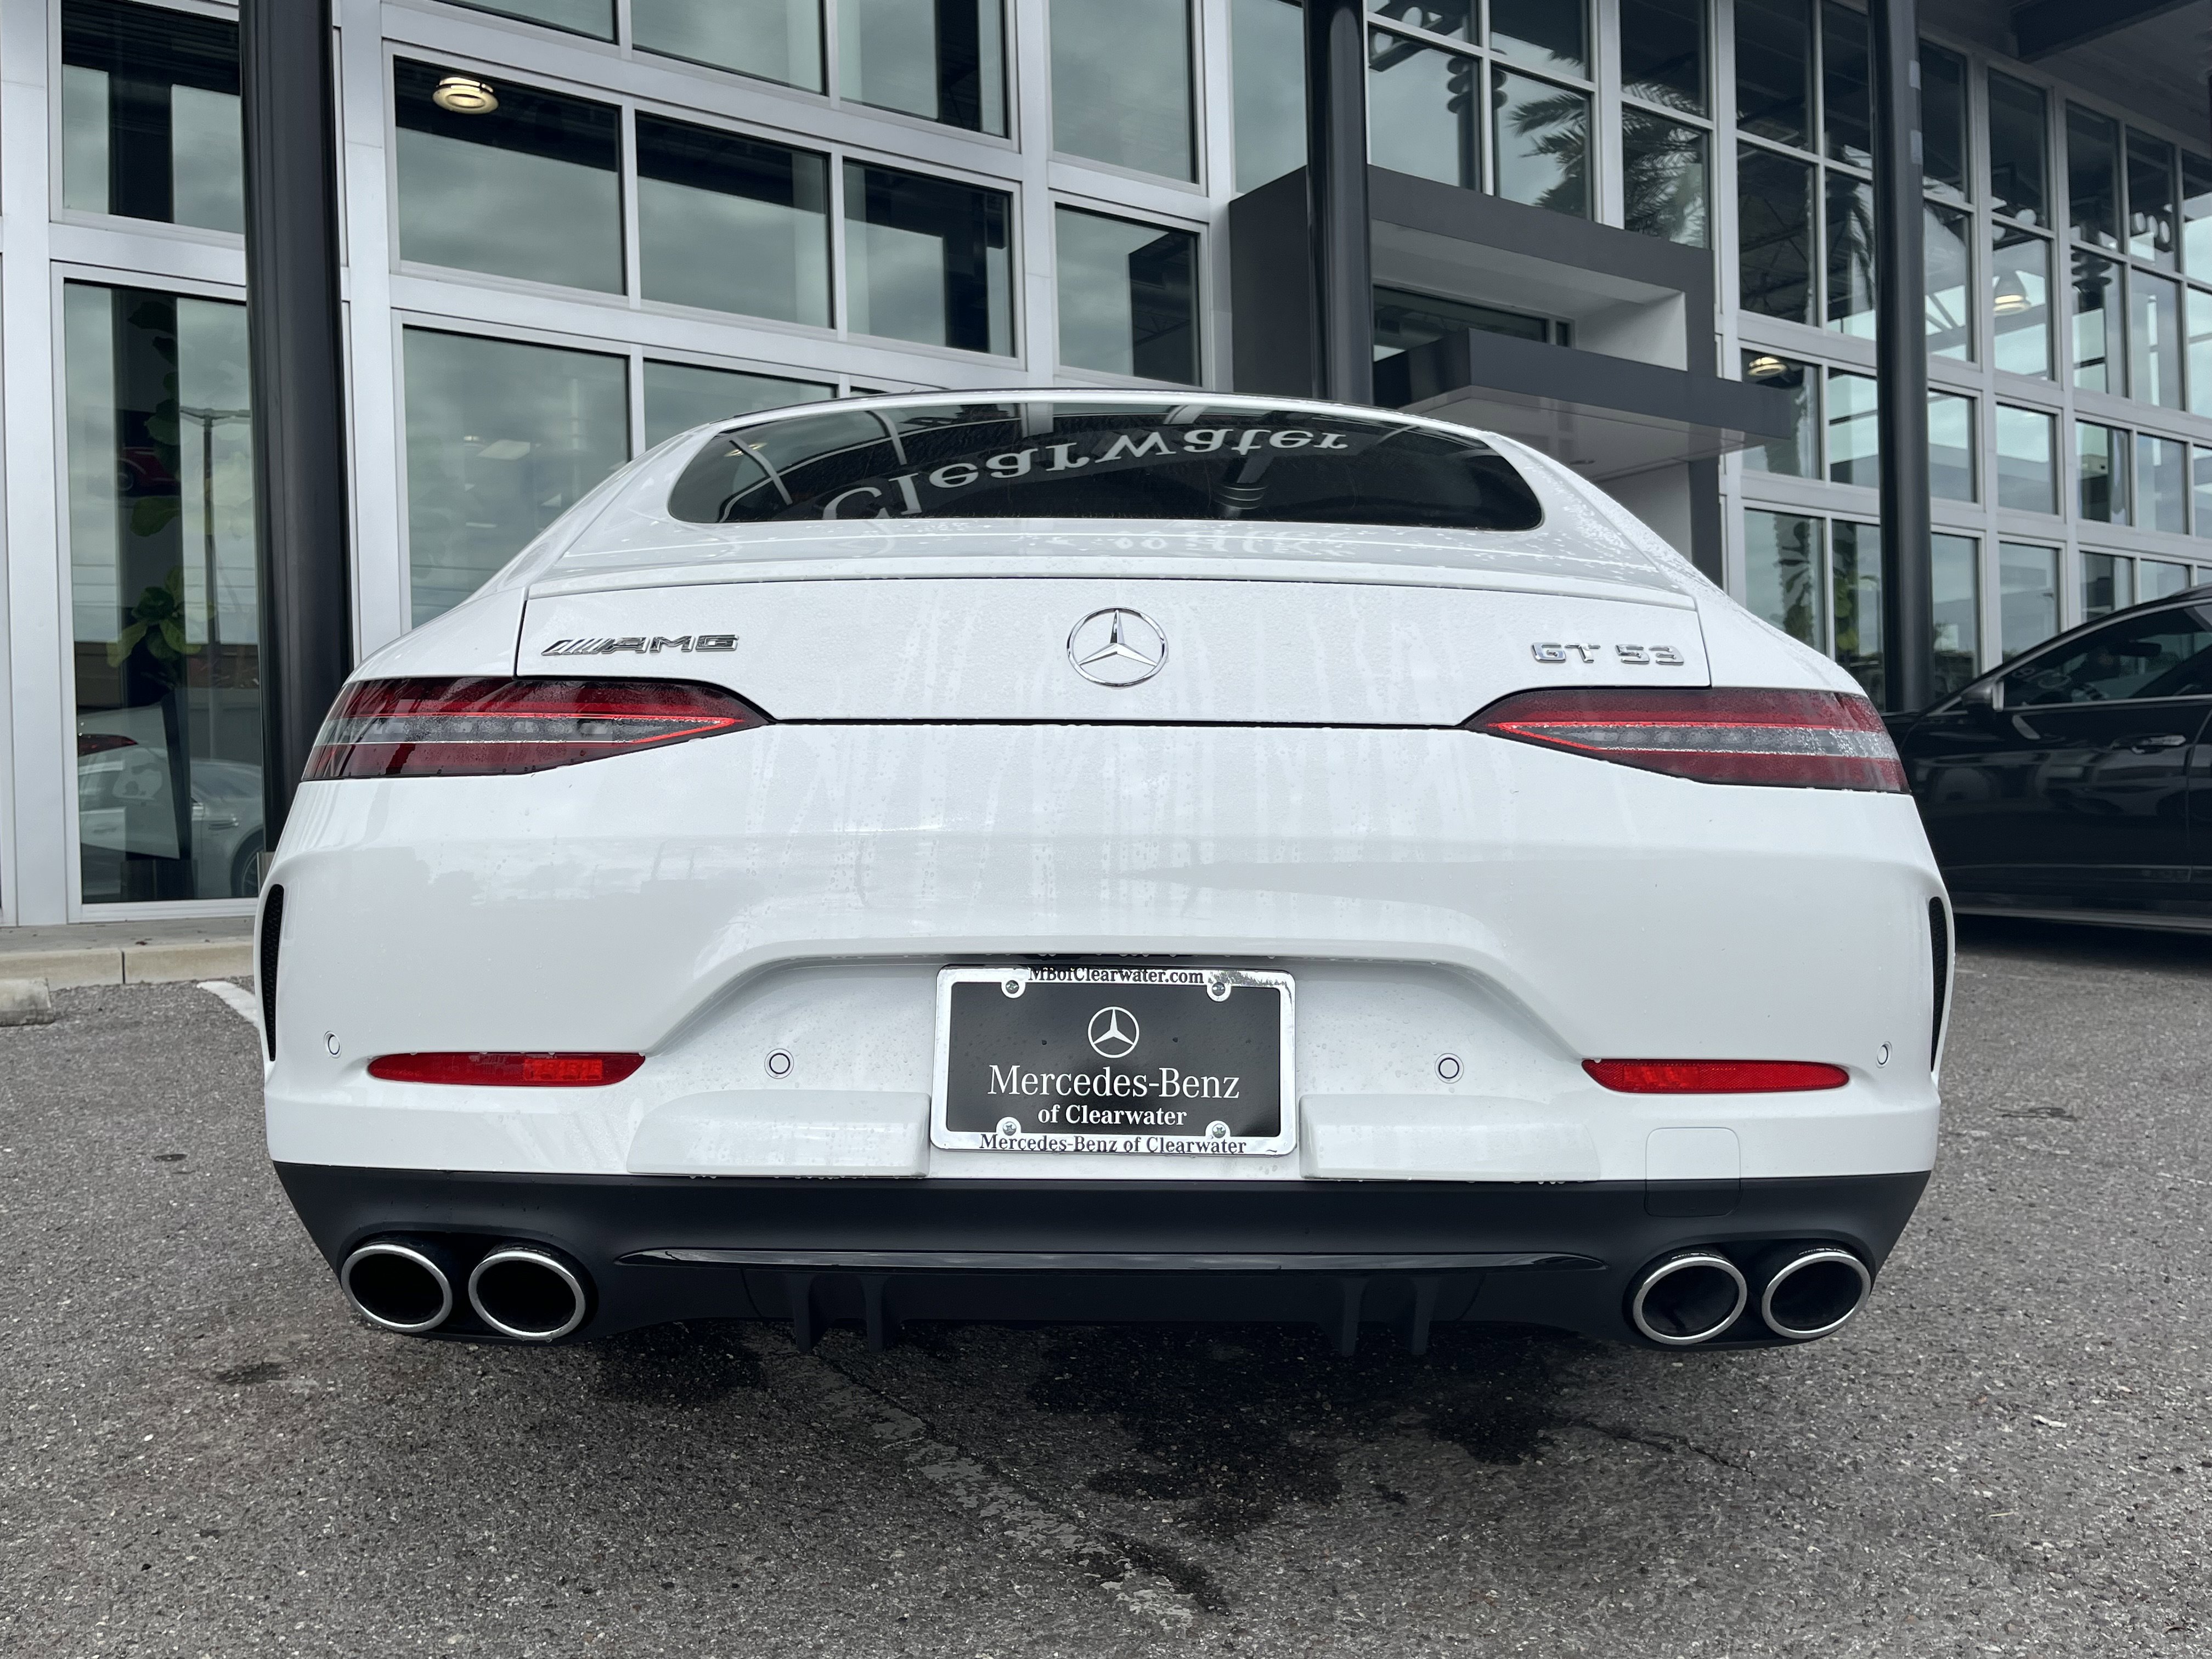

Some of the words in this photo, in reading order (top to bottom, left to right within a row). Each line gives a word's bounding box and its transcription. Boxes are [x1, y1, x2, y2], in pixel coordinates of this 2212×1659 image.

[1530, 642, 1601, 663] GT
[1615, 643, 1684, 666] 53
[1028, 967, 1204, 984] MBofClearwater.com
[987, 1064, 1240, 1099] Mercedes-Benz
[1037, 1105, 1060, 1125] of
[1065, 1104, 1188, 1126] Clearwater
[979, 1133, 1118, 1153] Mercedes-Benz
[1123, 1137, 1142, 1153] of
[1146, 1137, 1247, 1155] Clearwater
